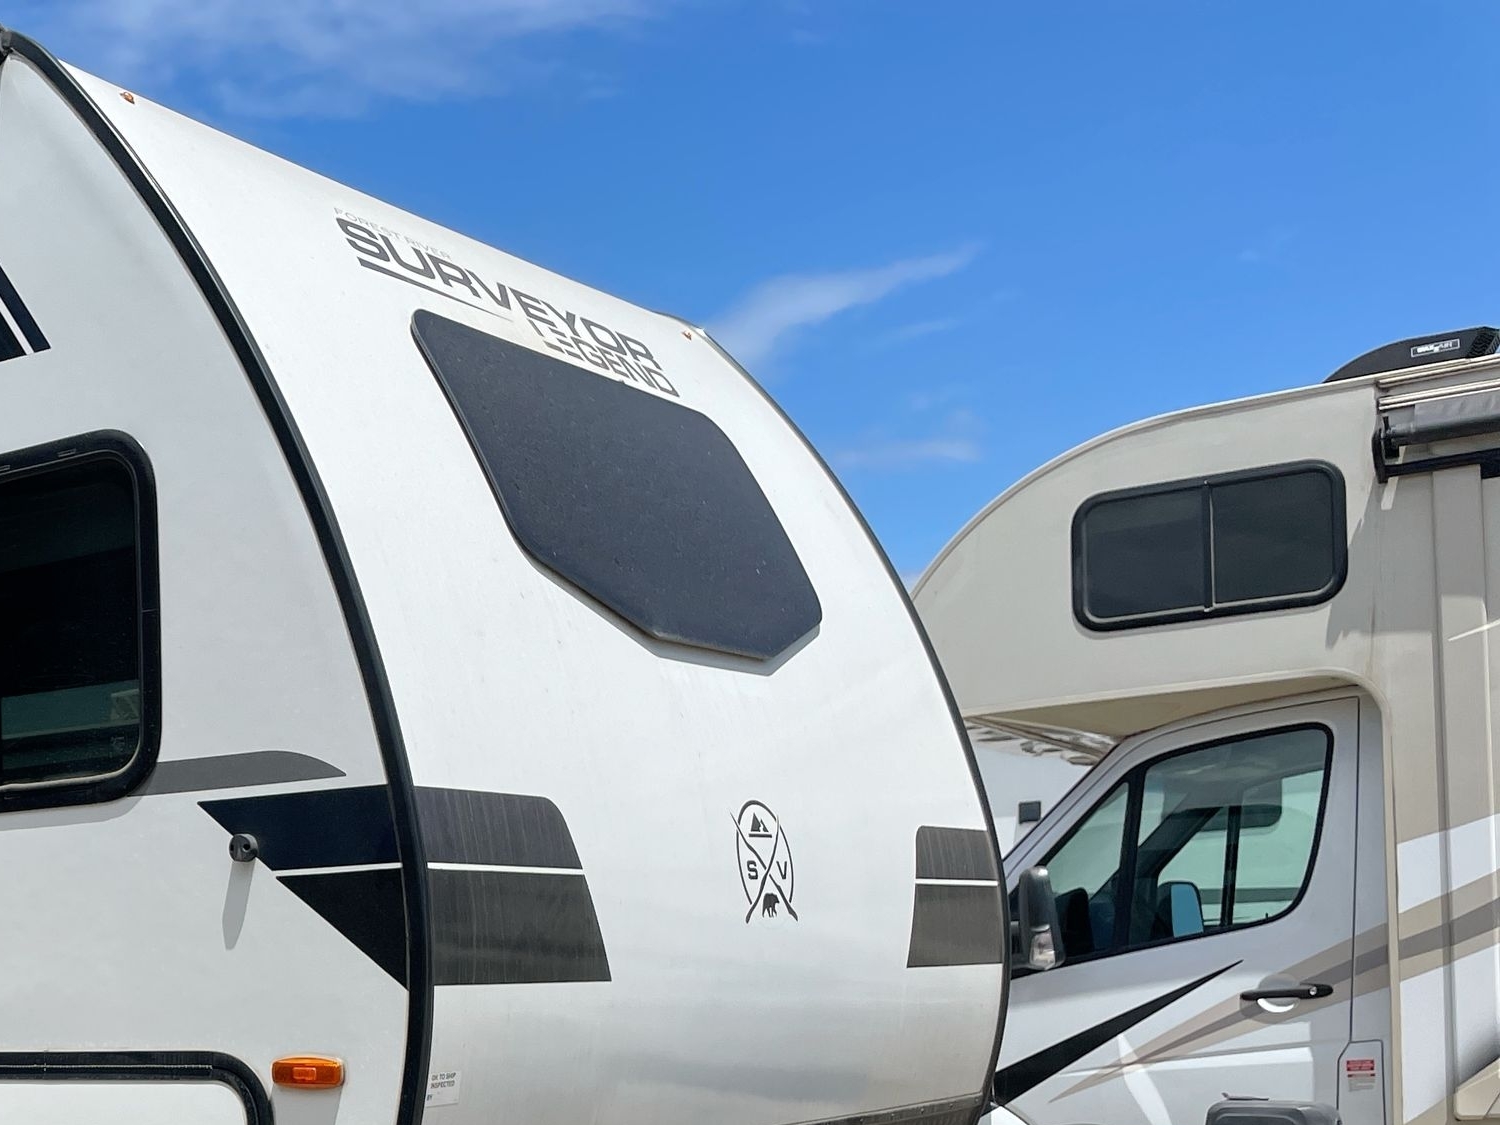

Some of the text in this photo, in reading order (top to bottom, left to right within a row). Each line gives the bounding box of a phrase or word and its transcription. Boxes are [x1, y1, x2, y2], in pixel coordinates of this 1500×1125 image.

[336, 217, 662, 371] SURVEYOR
[528, 319, 680, 398] LEGEND
[746, 860, 788, 880] S V
